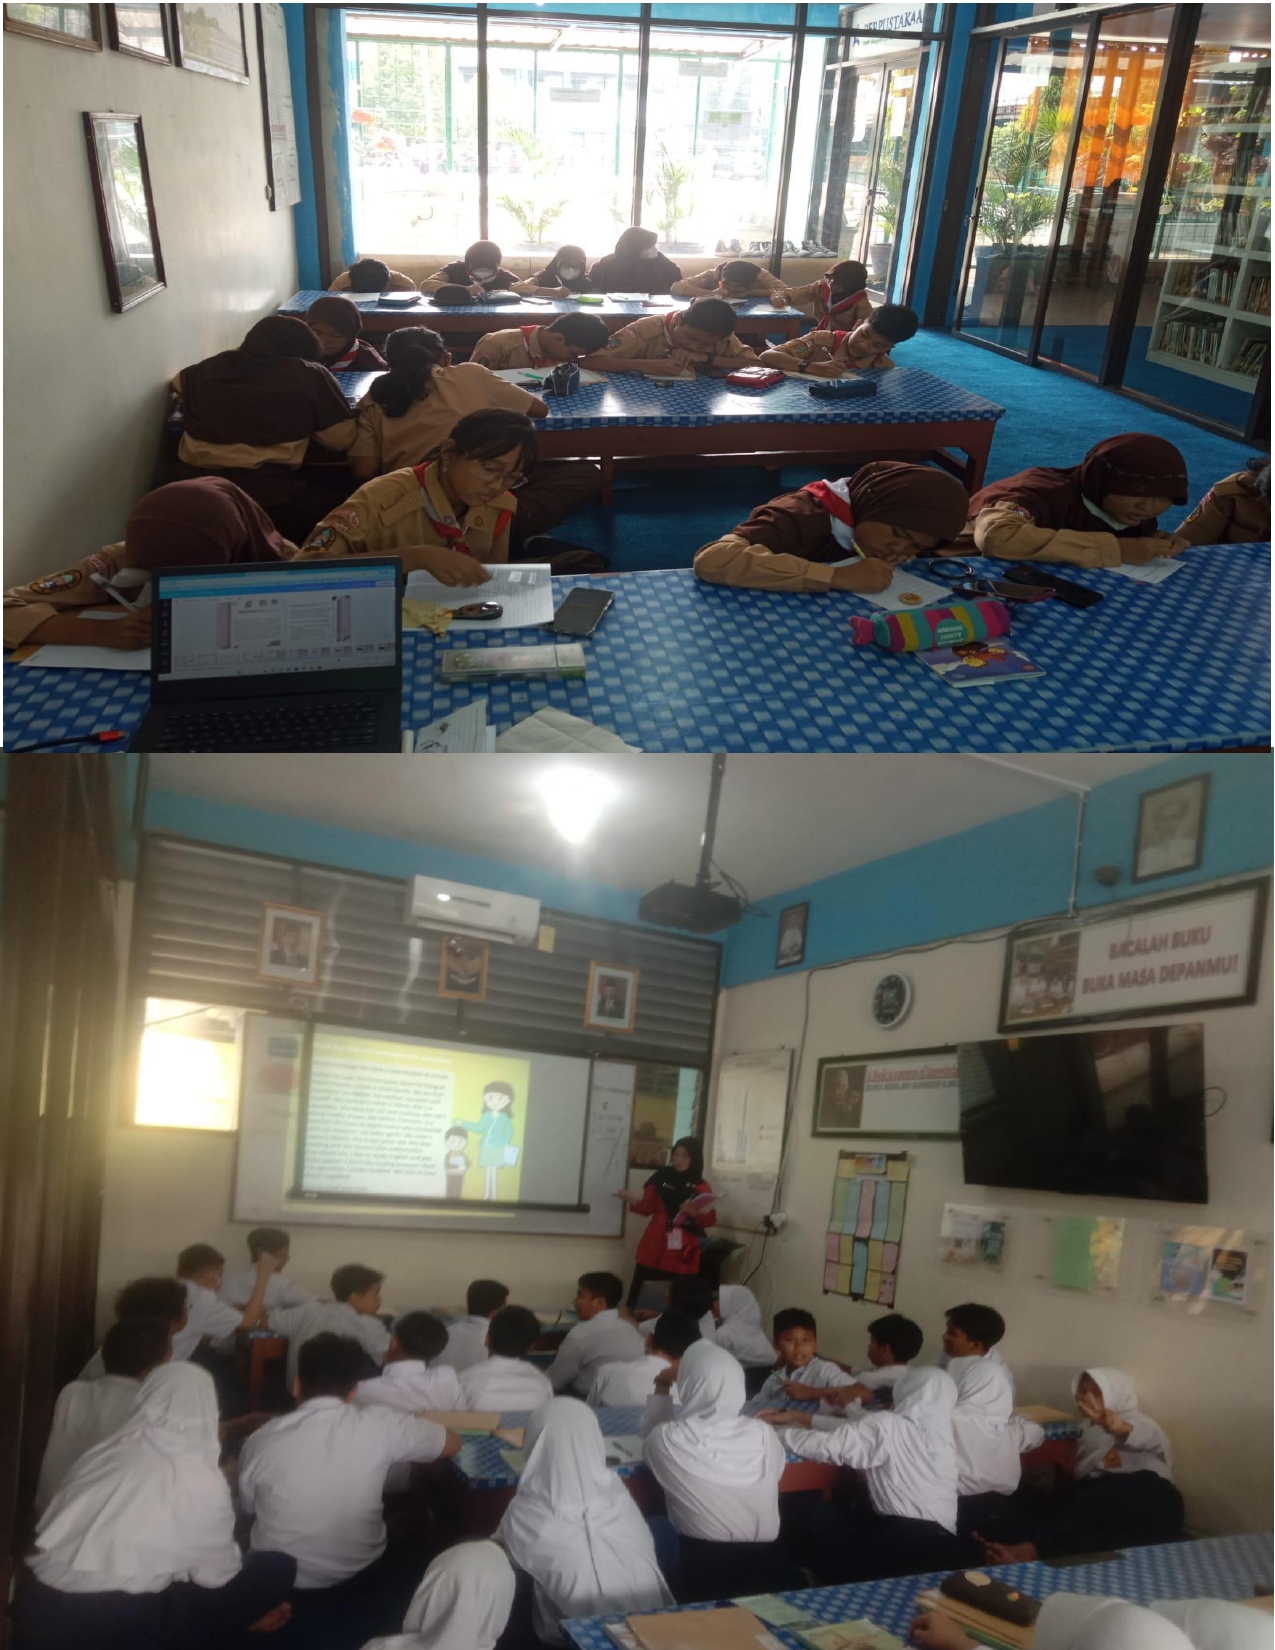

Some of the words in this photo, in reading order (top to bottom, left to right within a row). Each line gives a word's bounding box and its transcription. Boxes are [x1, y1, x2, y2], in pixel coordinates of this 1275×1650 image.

[1109, 932, 1169, 960] BACALAH
[1172, 925, 1212, 950] BUKU
[1082, 974, 1115, 995] BUKA
[1117, 967, 1156, 988] MASA
[1159, 953, 1239, 984] DEPANMU!
